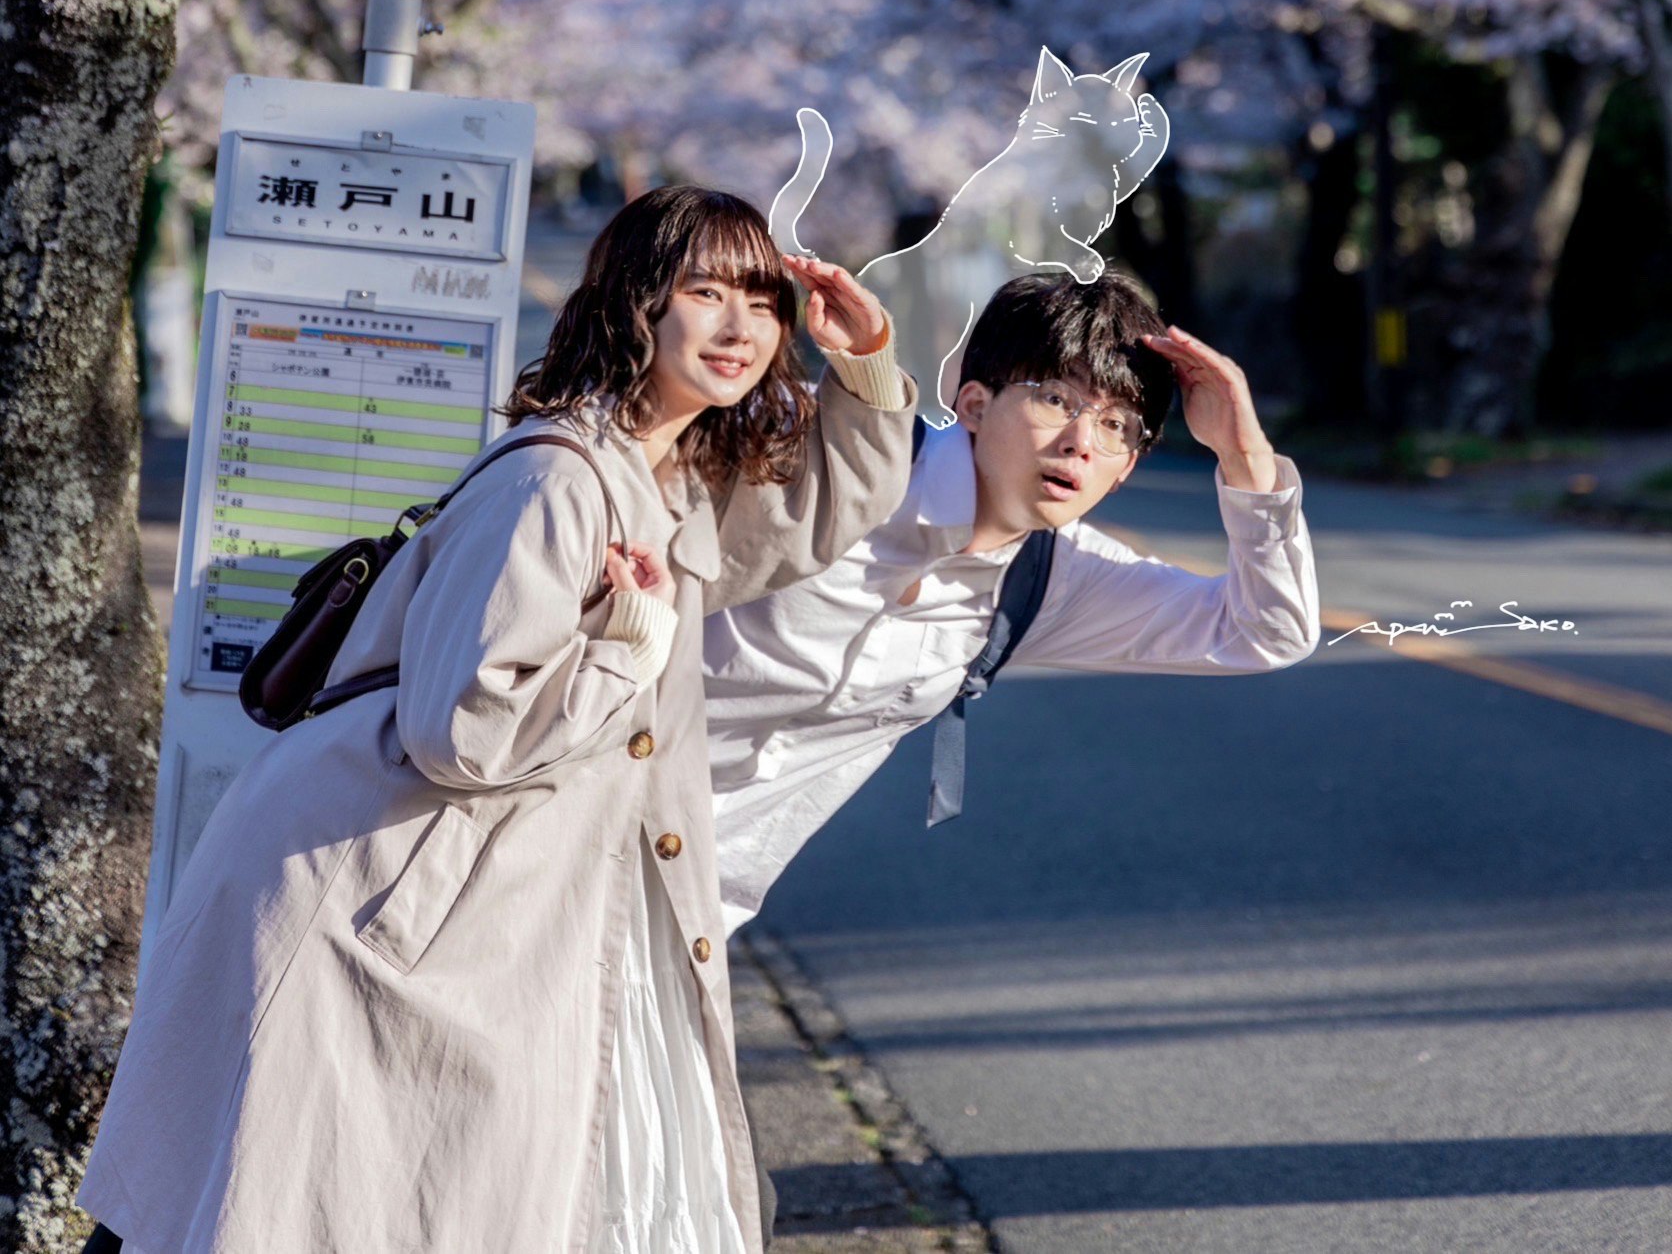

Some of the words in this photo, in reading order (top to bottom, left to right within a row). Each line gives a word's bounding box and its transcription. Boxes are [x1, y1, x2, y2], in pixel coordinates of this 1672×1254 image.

[290, 159, 452, 181] せとやま
[257, 175, 476, 223] 瀬戸山
[272, 215, 459, 241] SETOYAMA
